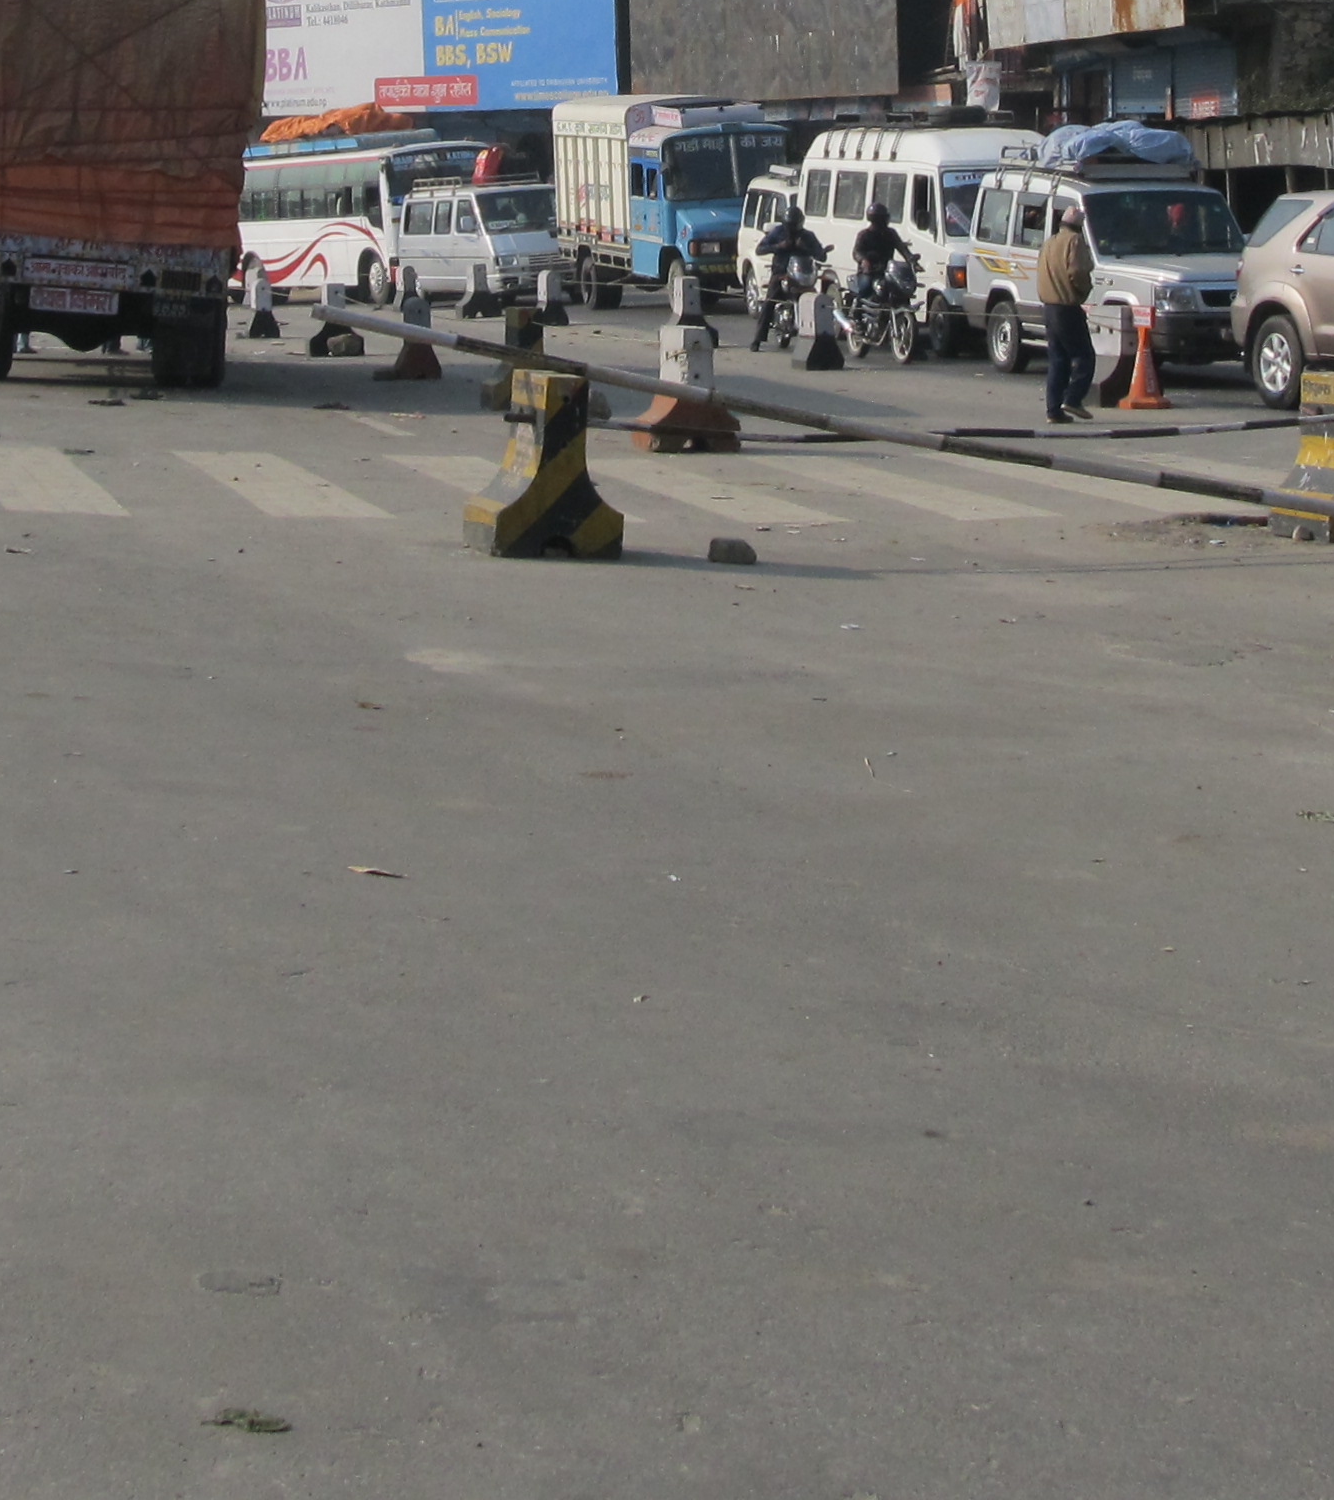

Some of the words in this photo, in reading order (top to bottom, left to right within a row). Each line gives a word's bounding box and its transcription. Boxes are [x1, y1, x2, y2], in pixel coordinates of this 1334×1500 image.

[435, 15, 454, 36] BA
[264, 46, 308, 83] BBA
[436, 44, 471, 68] BBS,
[476, 41, 513, 64] BSW
